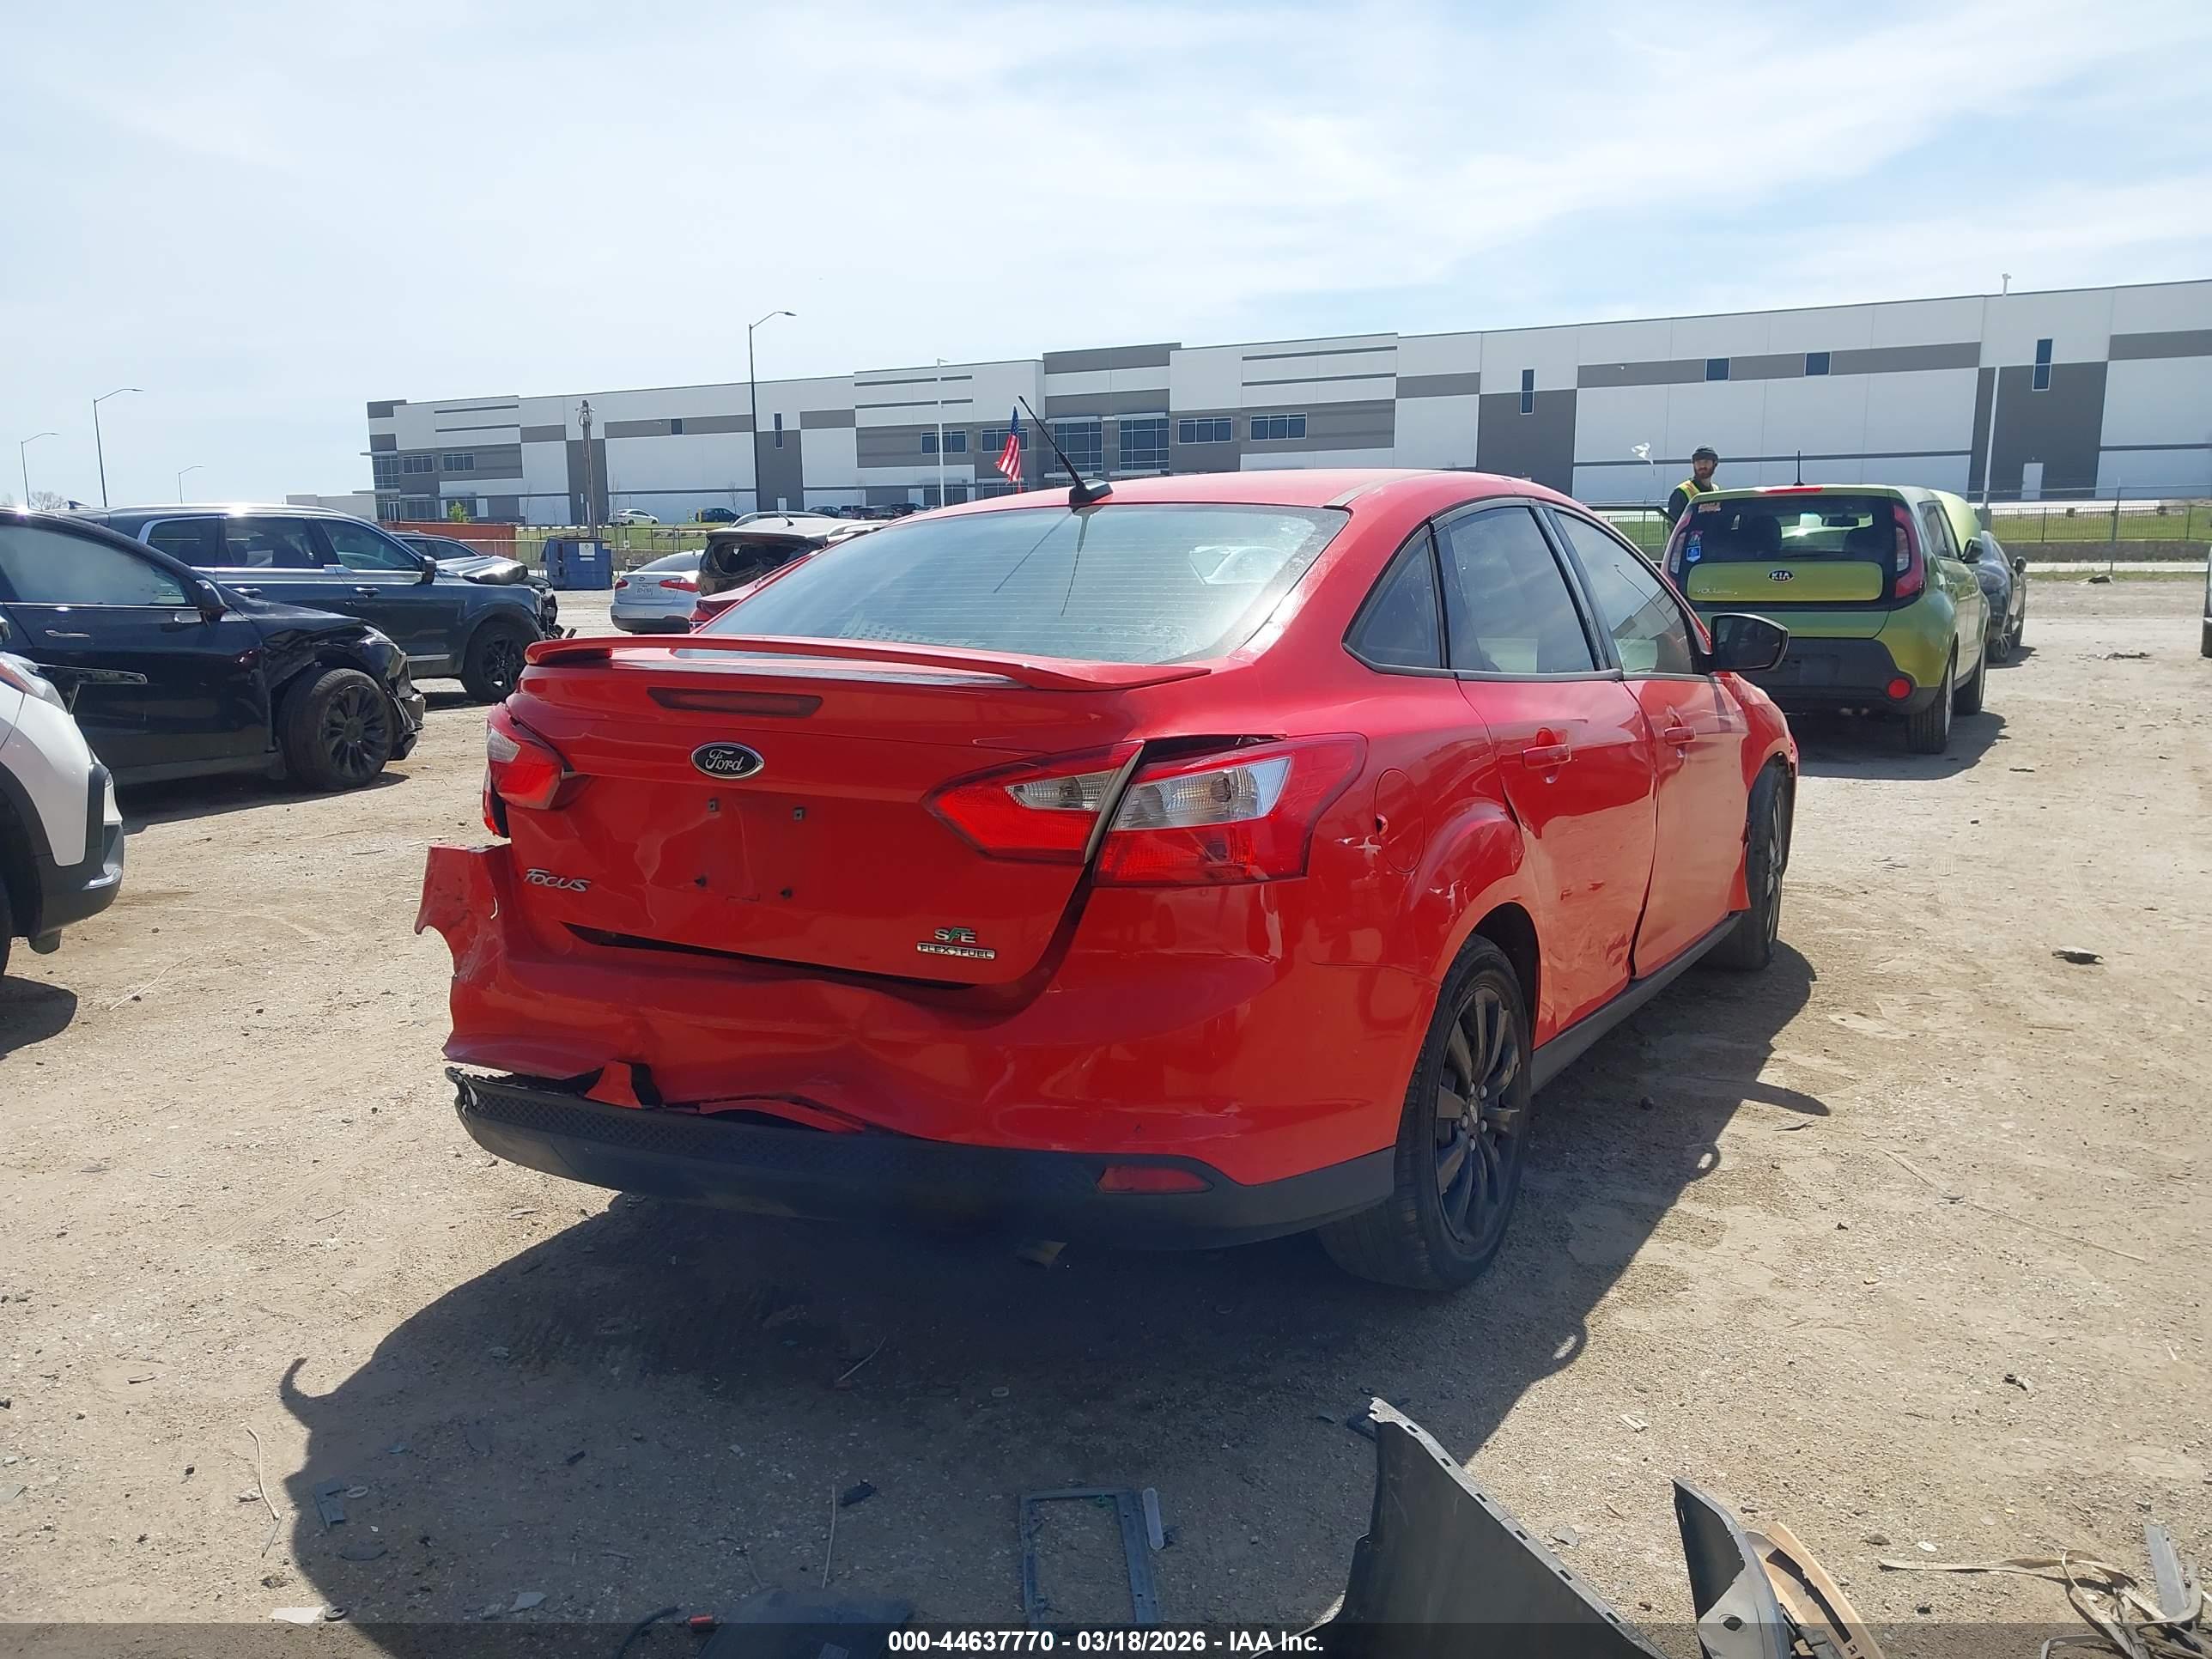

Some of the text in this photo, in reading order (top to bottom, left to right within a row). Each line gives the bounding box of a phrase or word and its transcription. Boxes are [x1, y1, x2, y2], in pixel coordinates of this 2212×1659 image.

[1771, 572, 1791, 580] KIA
[705, 749, 744, 771] Ford
[934, 927, 976, 944] SFE
[920, 944, 950, 954] FLEX
